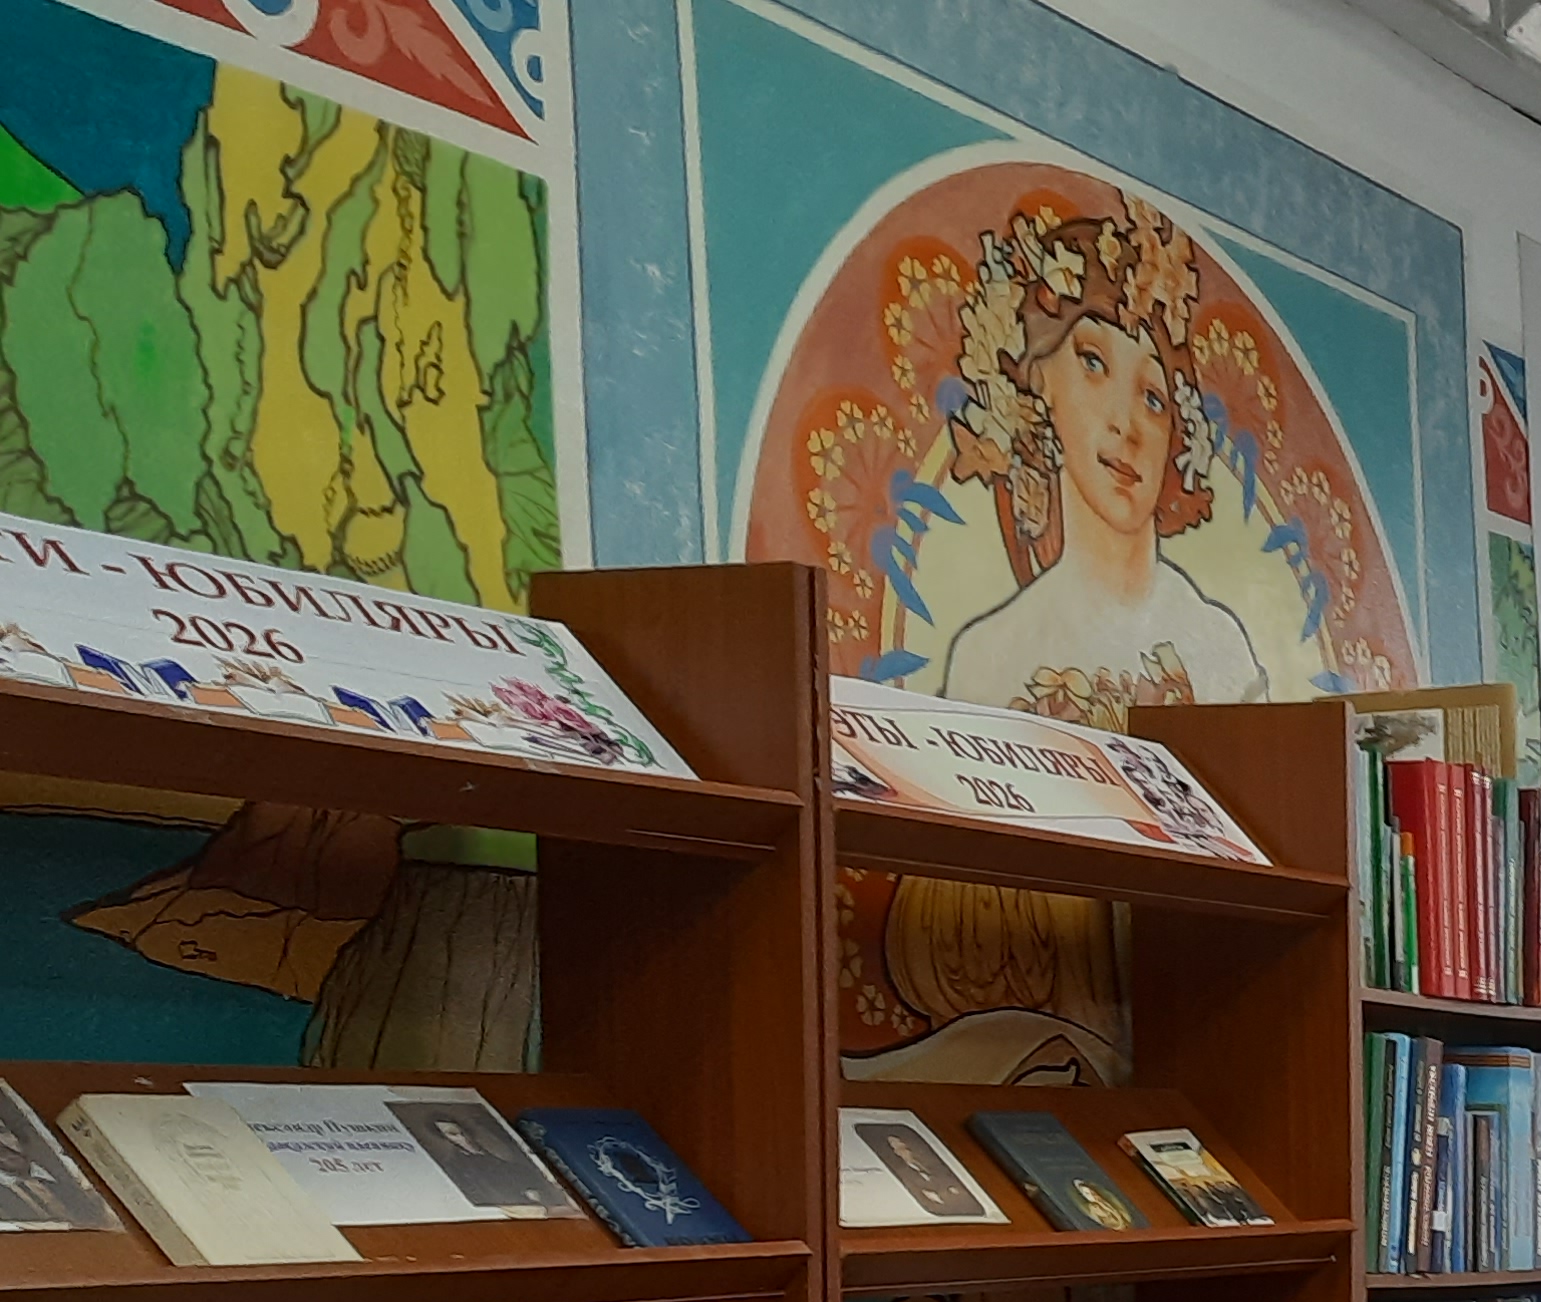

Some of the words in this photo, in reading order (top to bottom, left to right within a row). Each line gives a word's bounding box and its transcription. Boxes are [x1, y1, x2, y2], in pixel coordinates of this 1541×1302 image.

[127, 552, 526, 657] ЮБИЛЯРЫ
[151, 608, 304, 665] 2026
[933, 728, 1123, 787] ЮБИЛЯРЫ
[955, 773, 1035, 813] 2026
[309, 1157, 349, 1173] 205
